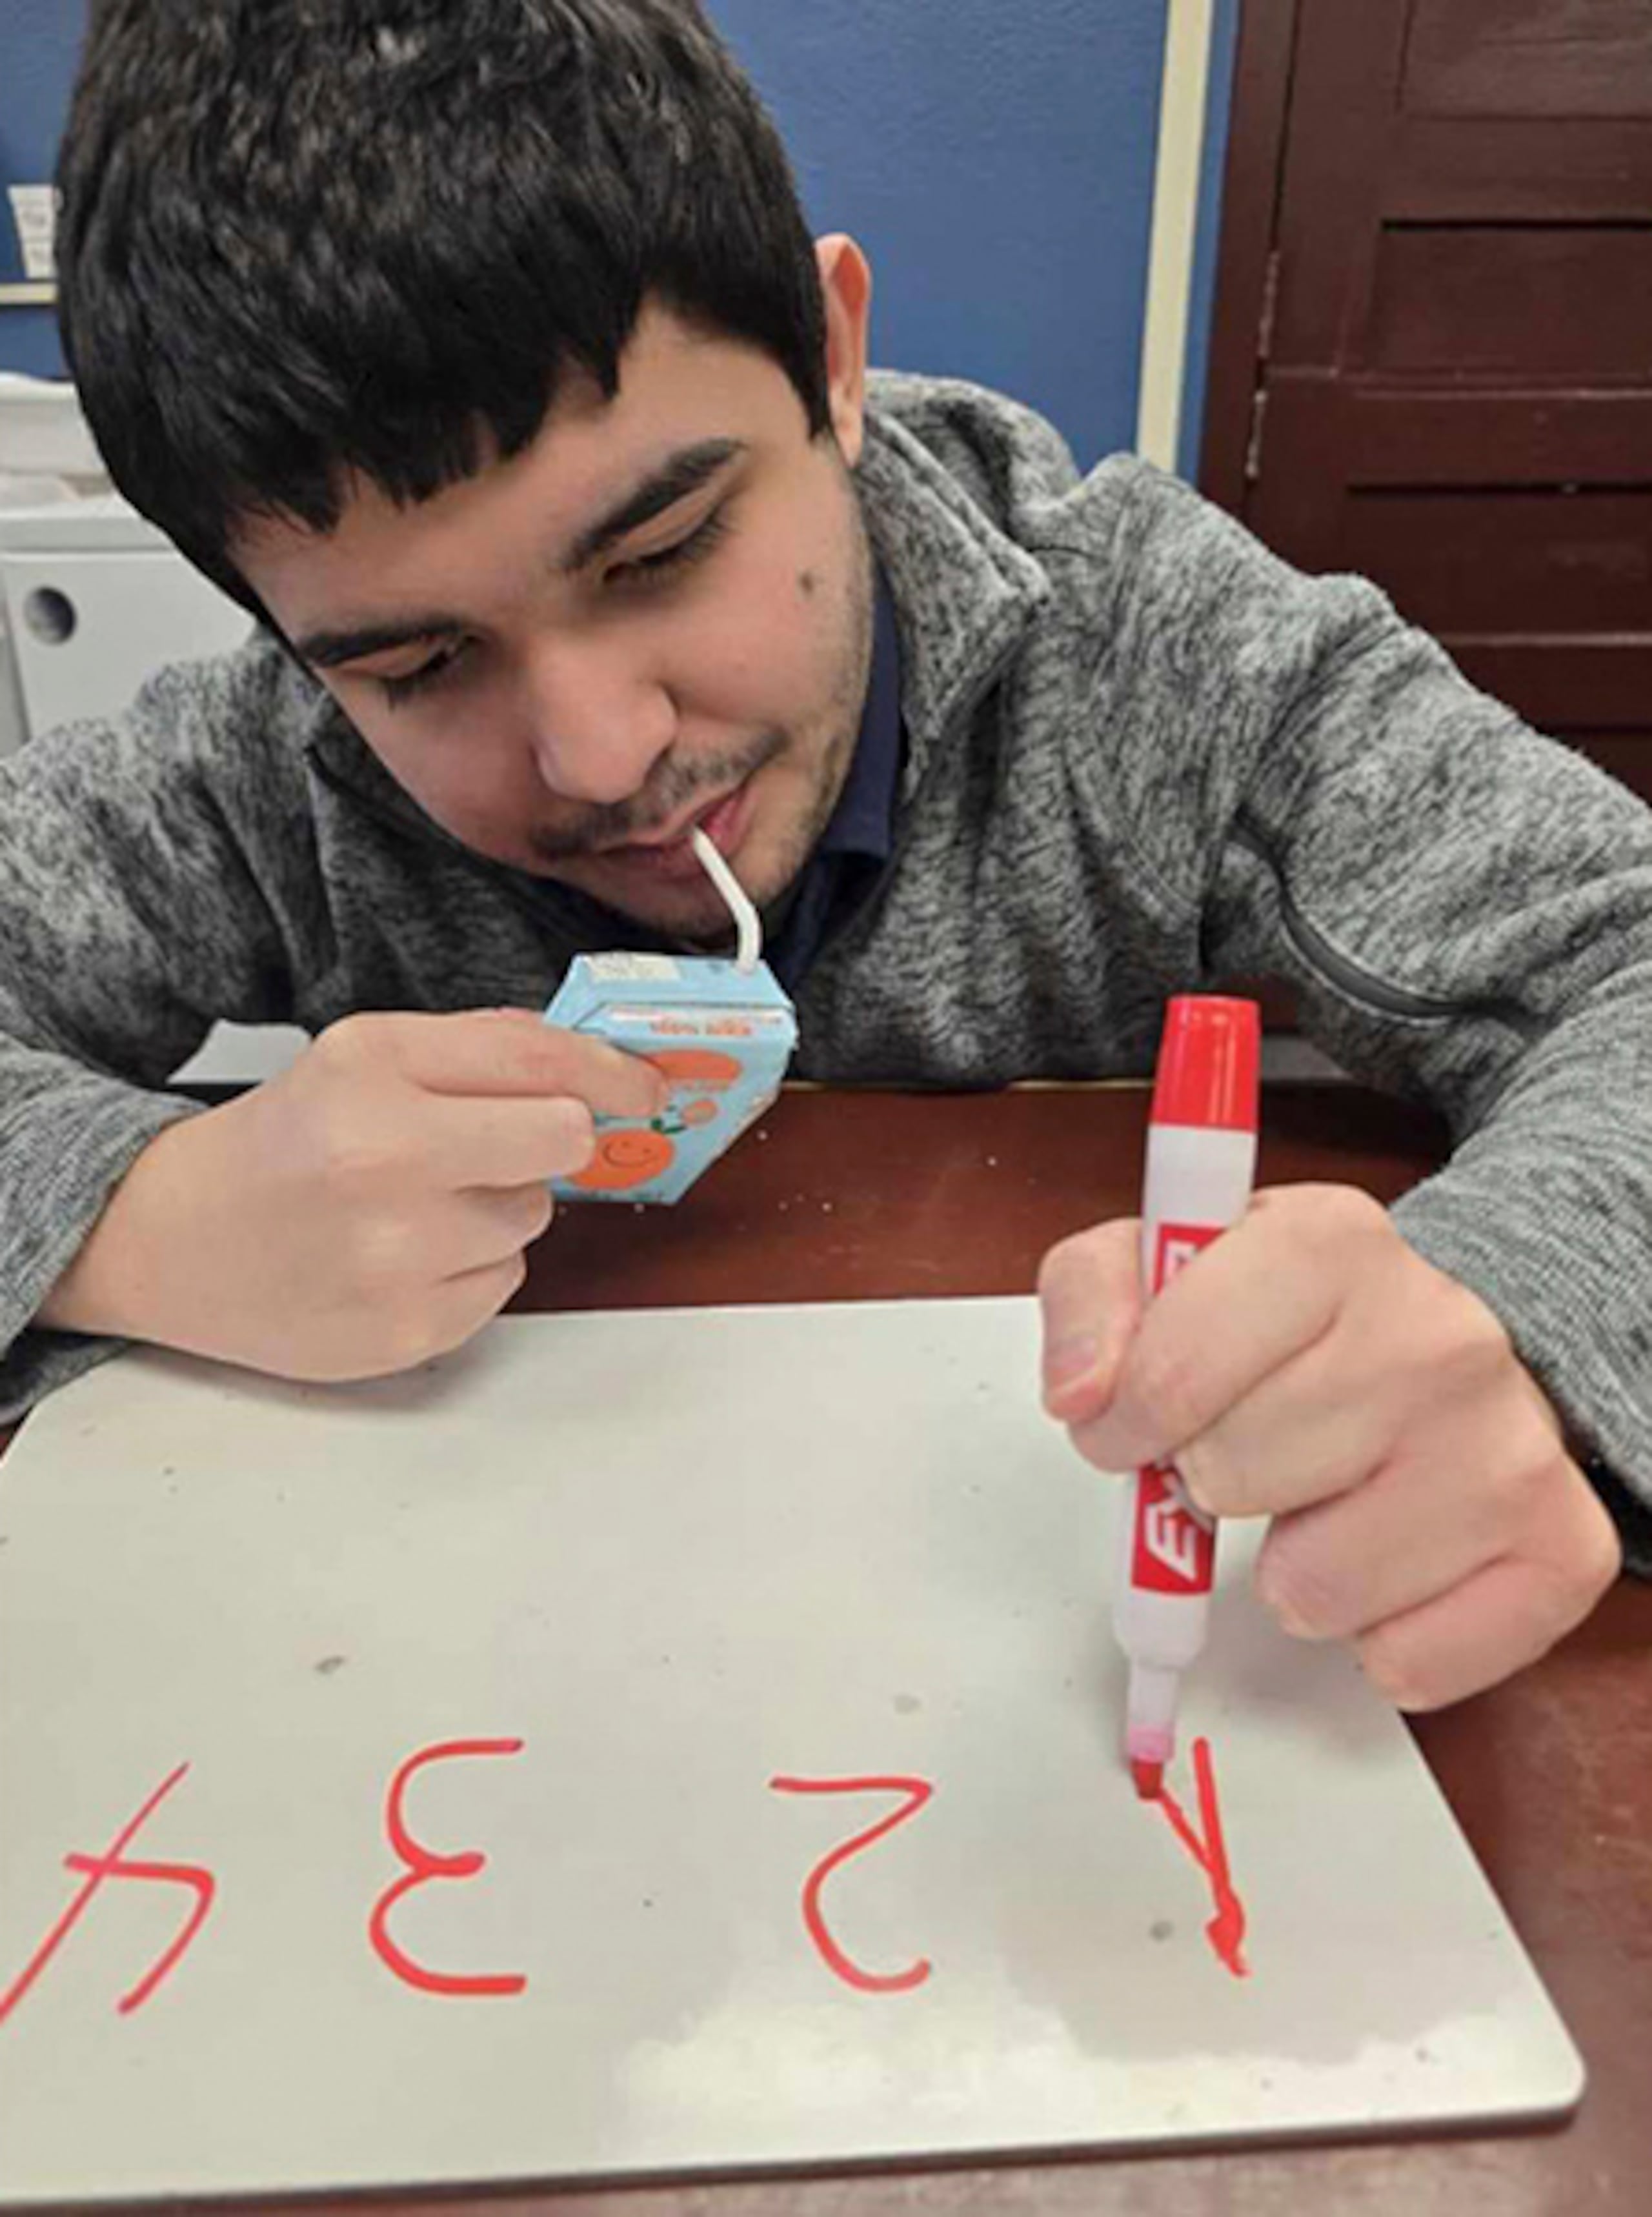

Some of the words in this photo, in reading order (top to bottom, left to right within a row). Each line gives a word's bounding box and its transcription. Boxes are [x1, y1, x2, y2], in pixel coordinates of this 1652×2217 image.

[0, 1761, 216, 2025] 4
[368, 1737, 527, 1996] 3
[771, 1775, 933, 1992] 2
[1158, 1736, 1251, 1978] 1
